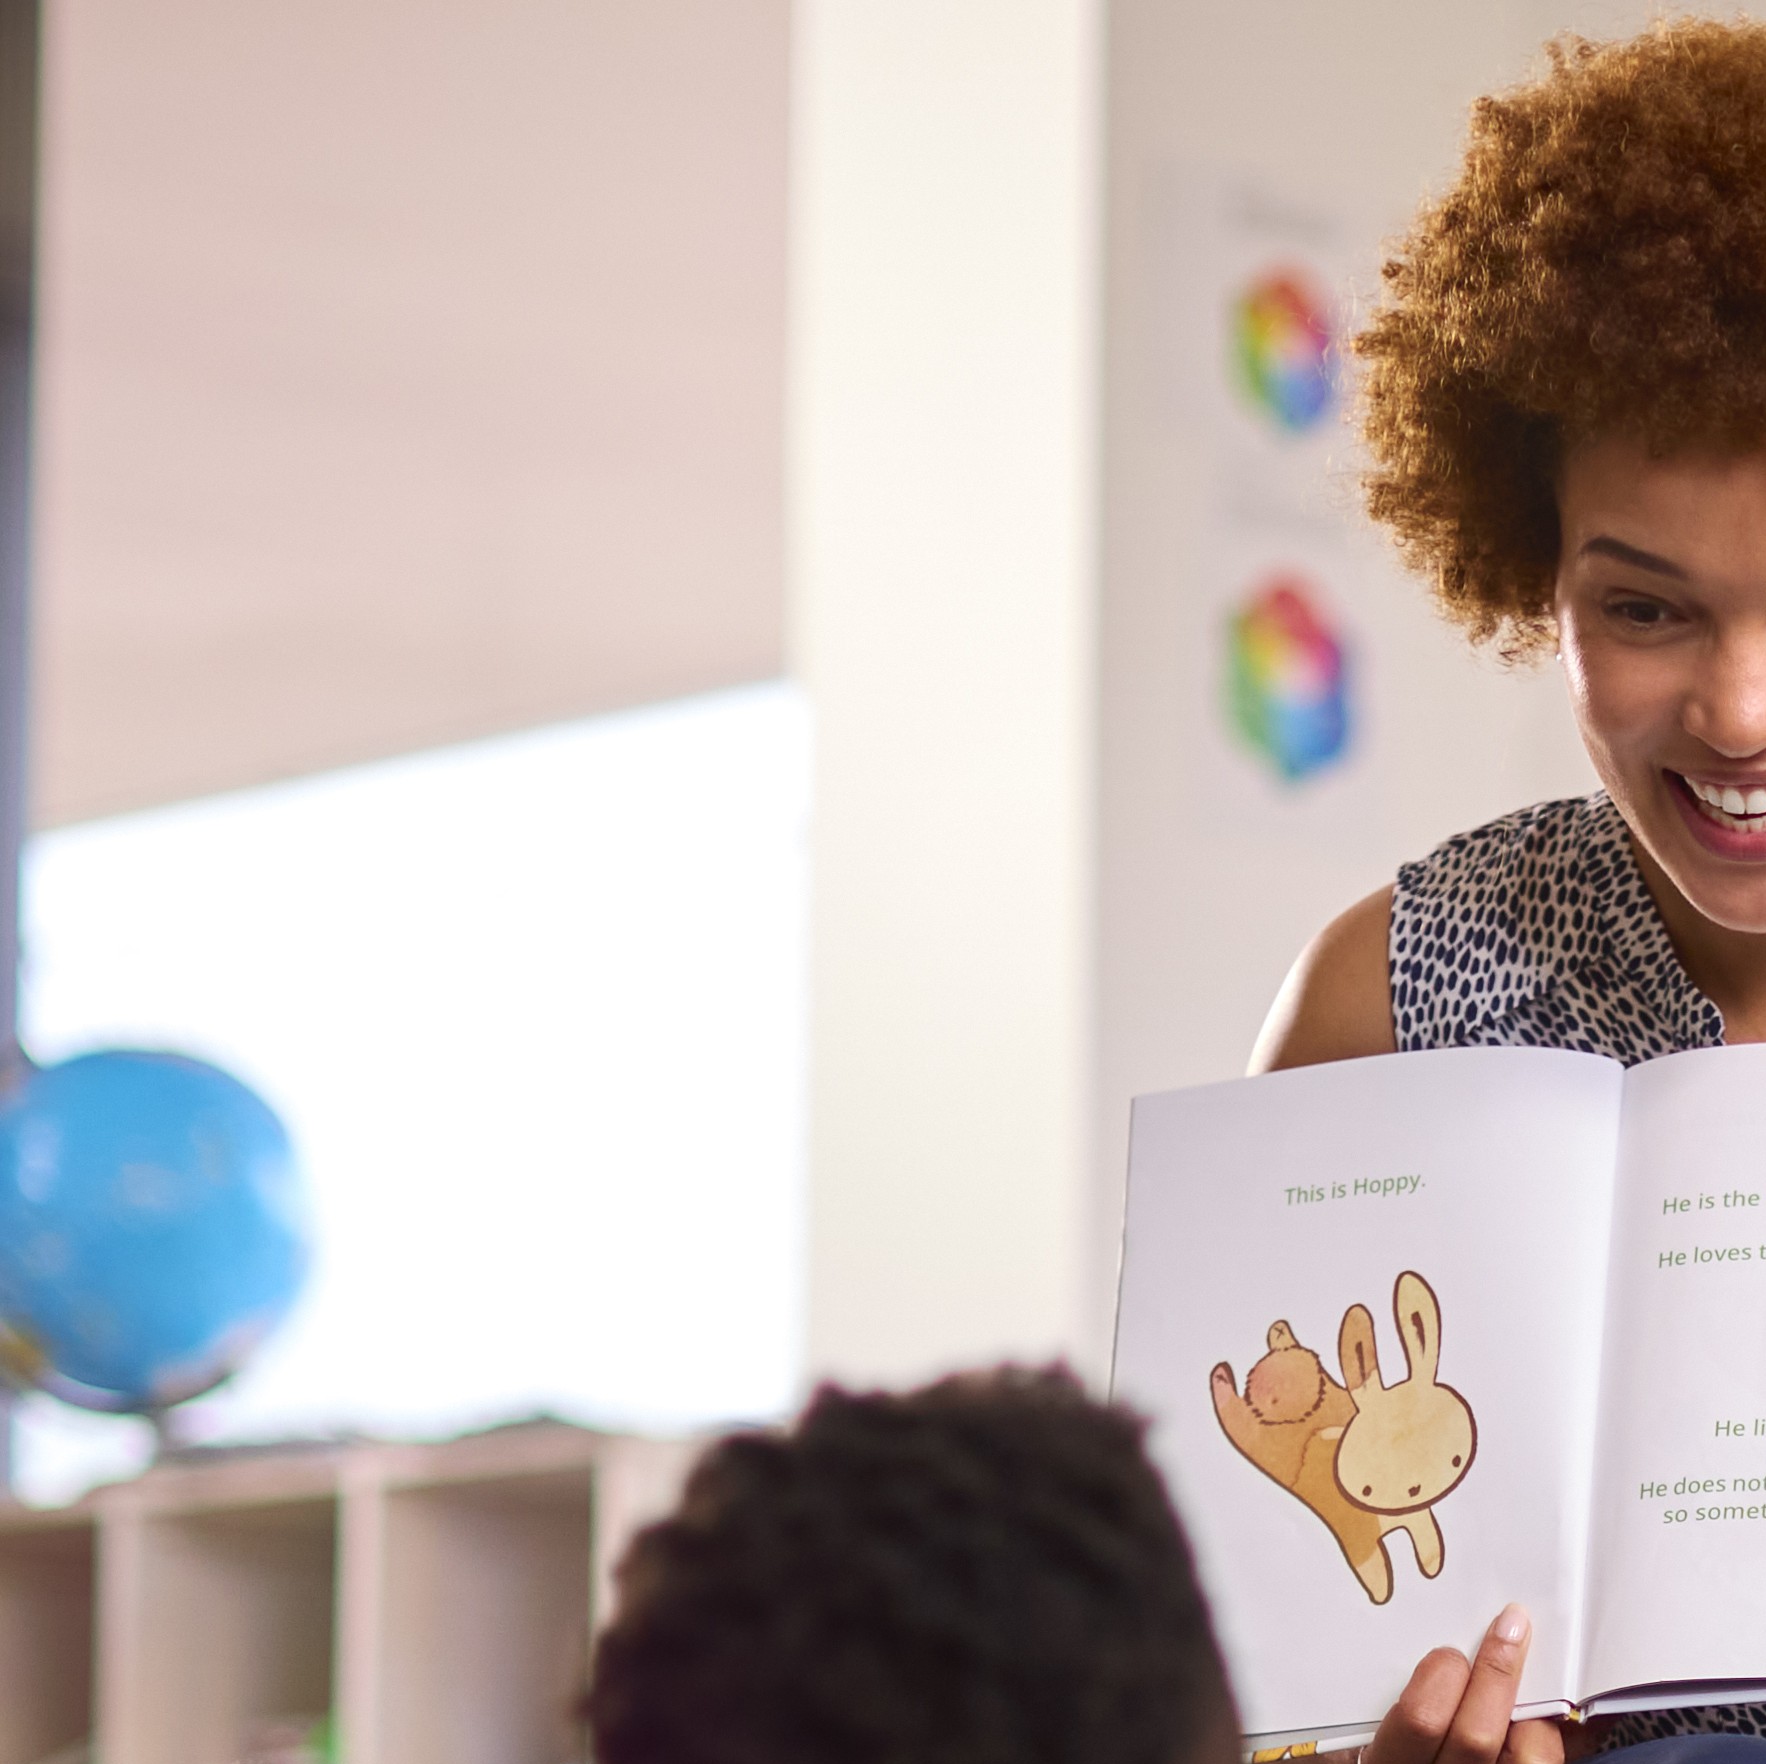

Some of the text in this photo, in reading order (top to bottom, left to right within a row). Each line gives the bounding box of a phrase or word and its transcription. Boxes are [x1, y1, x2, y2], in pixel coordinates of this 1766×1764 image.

[1286, 1175, 1425, 1205] This is Hoppy.
[1663, 1197, 1691, 1215] He
[1699, 1193, 1714, 1209] is
[1724, 1190, 1759, 1207] the
[1659, 1251, 1686, 1268] He
[1694, 1246, 1751, 1263] loves
[1715, 1420, 1745, 1437] He
[1640, 1482, 1667, 1499] He
[1674, 1477, 1725, 1495] does
[1664, 1509, 1687, 1524] so
